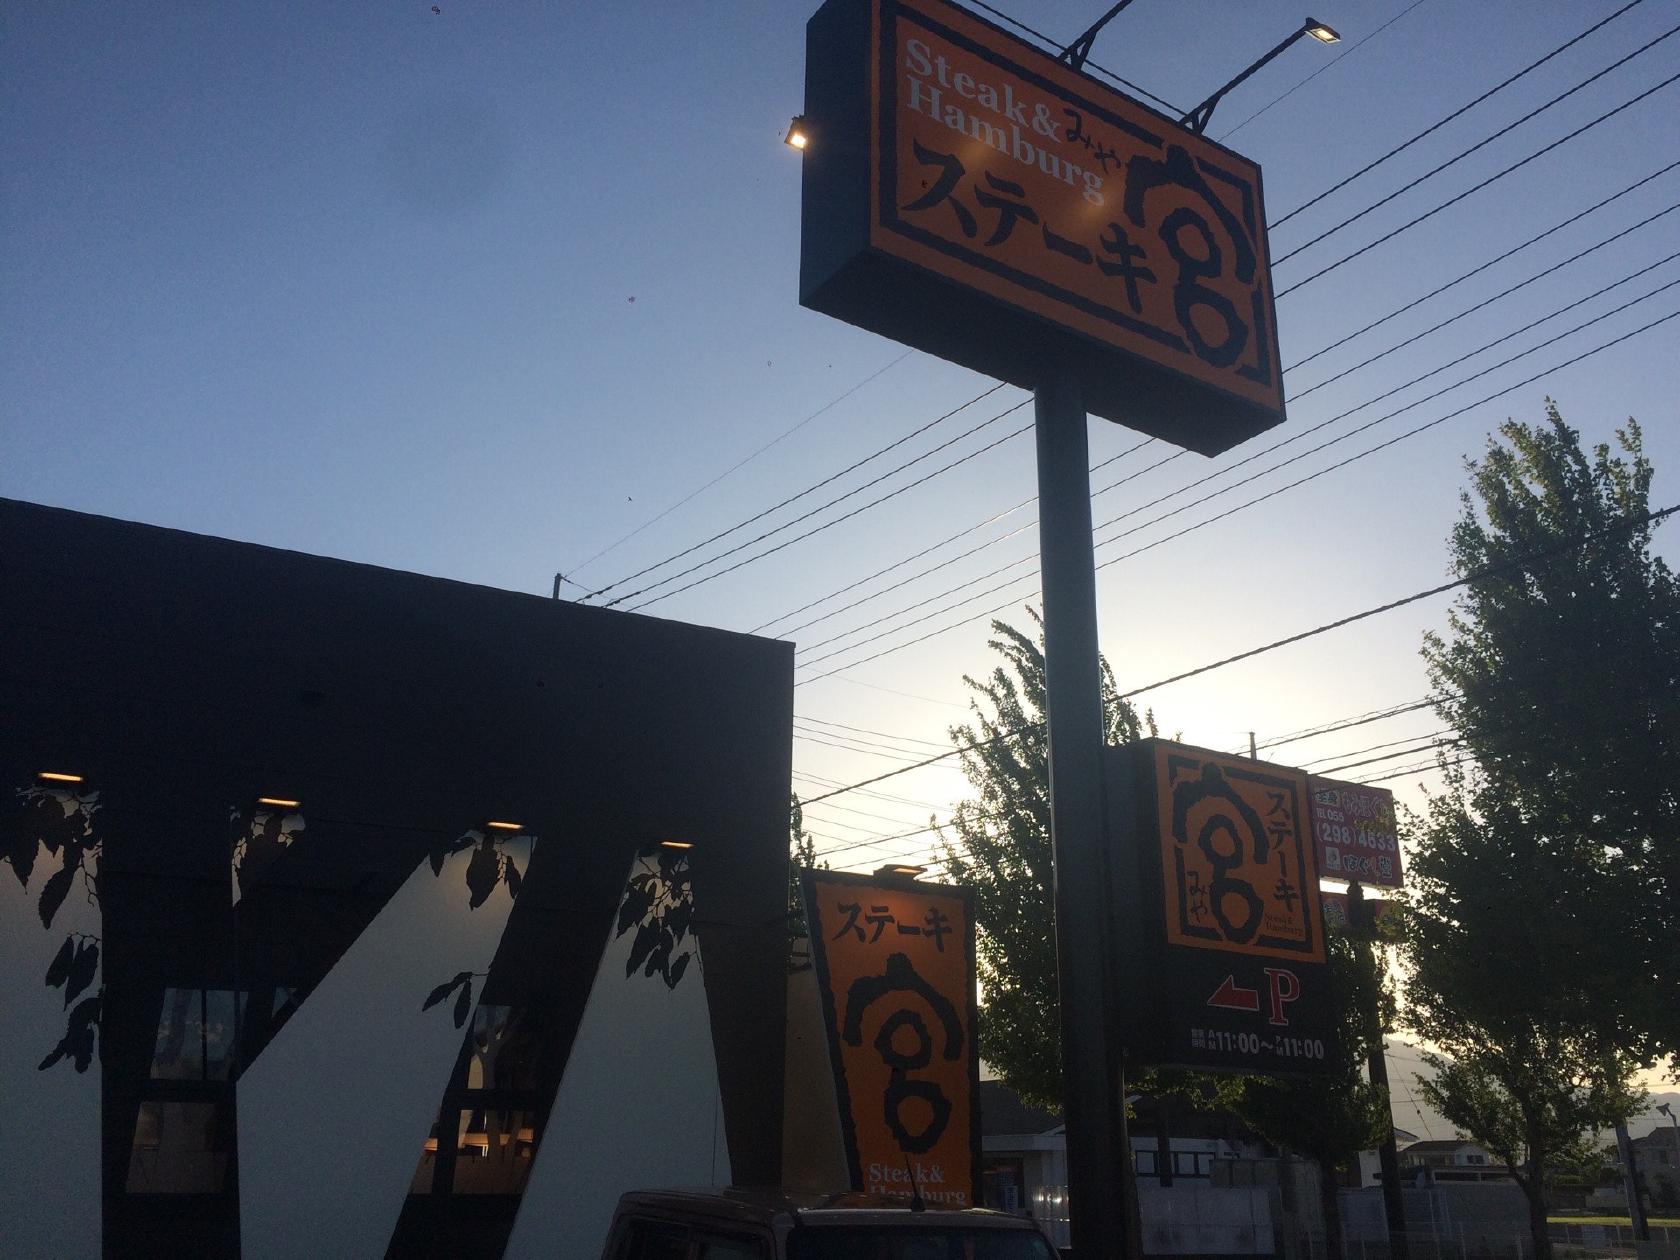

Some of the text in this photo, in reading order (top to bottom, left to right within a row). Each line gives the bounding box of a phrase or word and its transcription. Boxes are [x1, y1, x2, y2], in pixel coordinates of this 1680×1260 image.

[905, 37, 1060, 144] Steak&
[906, 75, 1105, 207] Hamburg
[1063, 108, 1122, 174] みや
[902, 136, 1158, 314] ステーキ
[1327, 809, 1345, 822] 055
[1266, 790, 1299, 913] ステーキ
[832, 902, 953, 953] ステーキ
[1263, 966, 1302, 1026] P
[868, 1162, 945, 1184] Steak&
